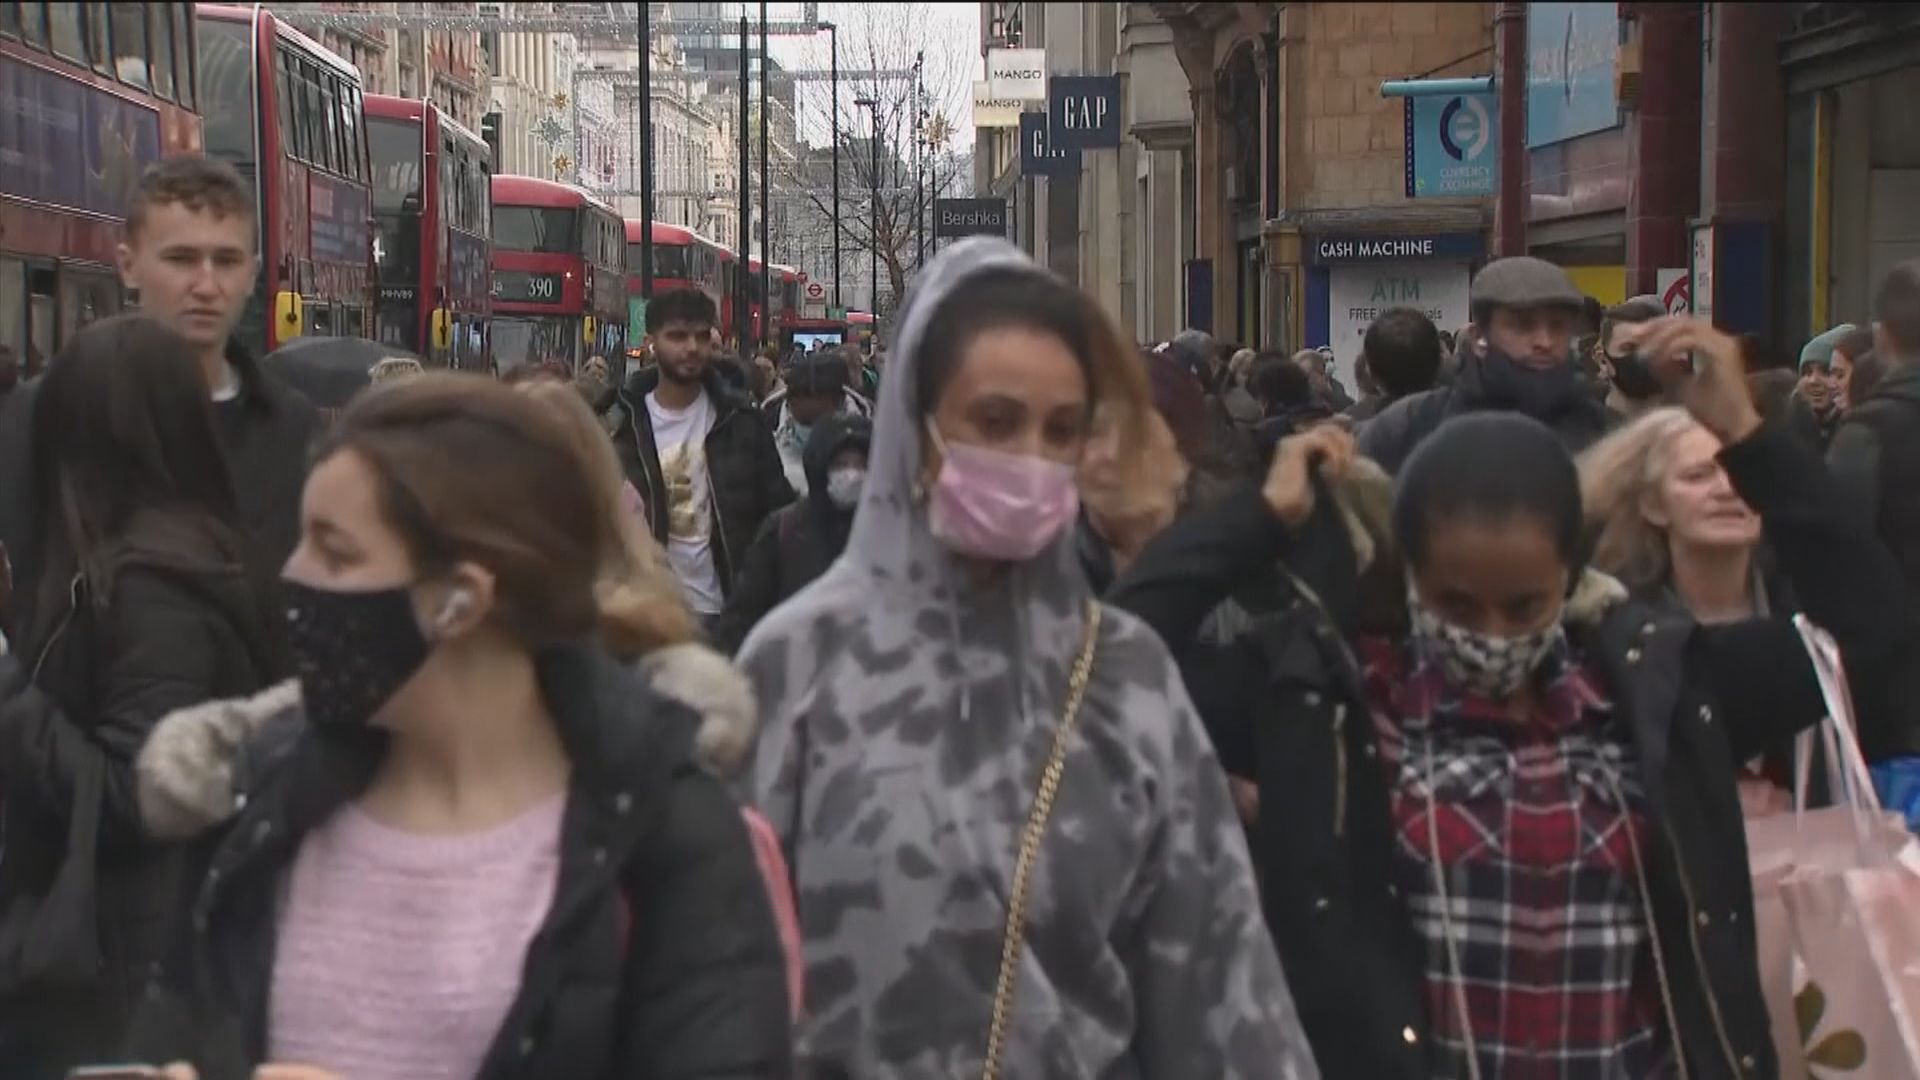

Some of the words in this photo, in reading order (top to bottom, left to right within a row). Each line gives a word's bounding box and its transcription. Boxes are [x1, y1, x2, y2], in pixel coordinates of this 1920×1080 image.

[993, 70, 1042, 80] MANGO
[975, 99, 1021, 107] MANGO
[1064, 96, 1107, 129] GAP
[942, 208, 1001, 226] Bershka
[1320, 241, 1353, 258] CASH
[1358, 239, 1433, 256] MACHINE
[528, 277, 553, 297] 390
[1372, 278, 1420, 302] ATM
[1349, 307, 1377, 321] FREE
